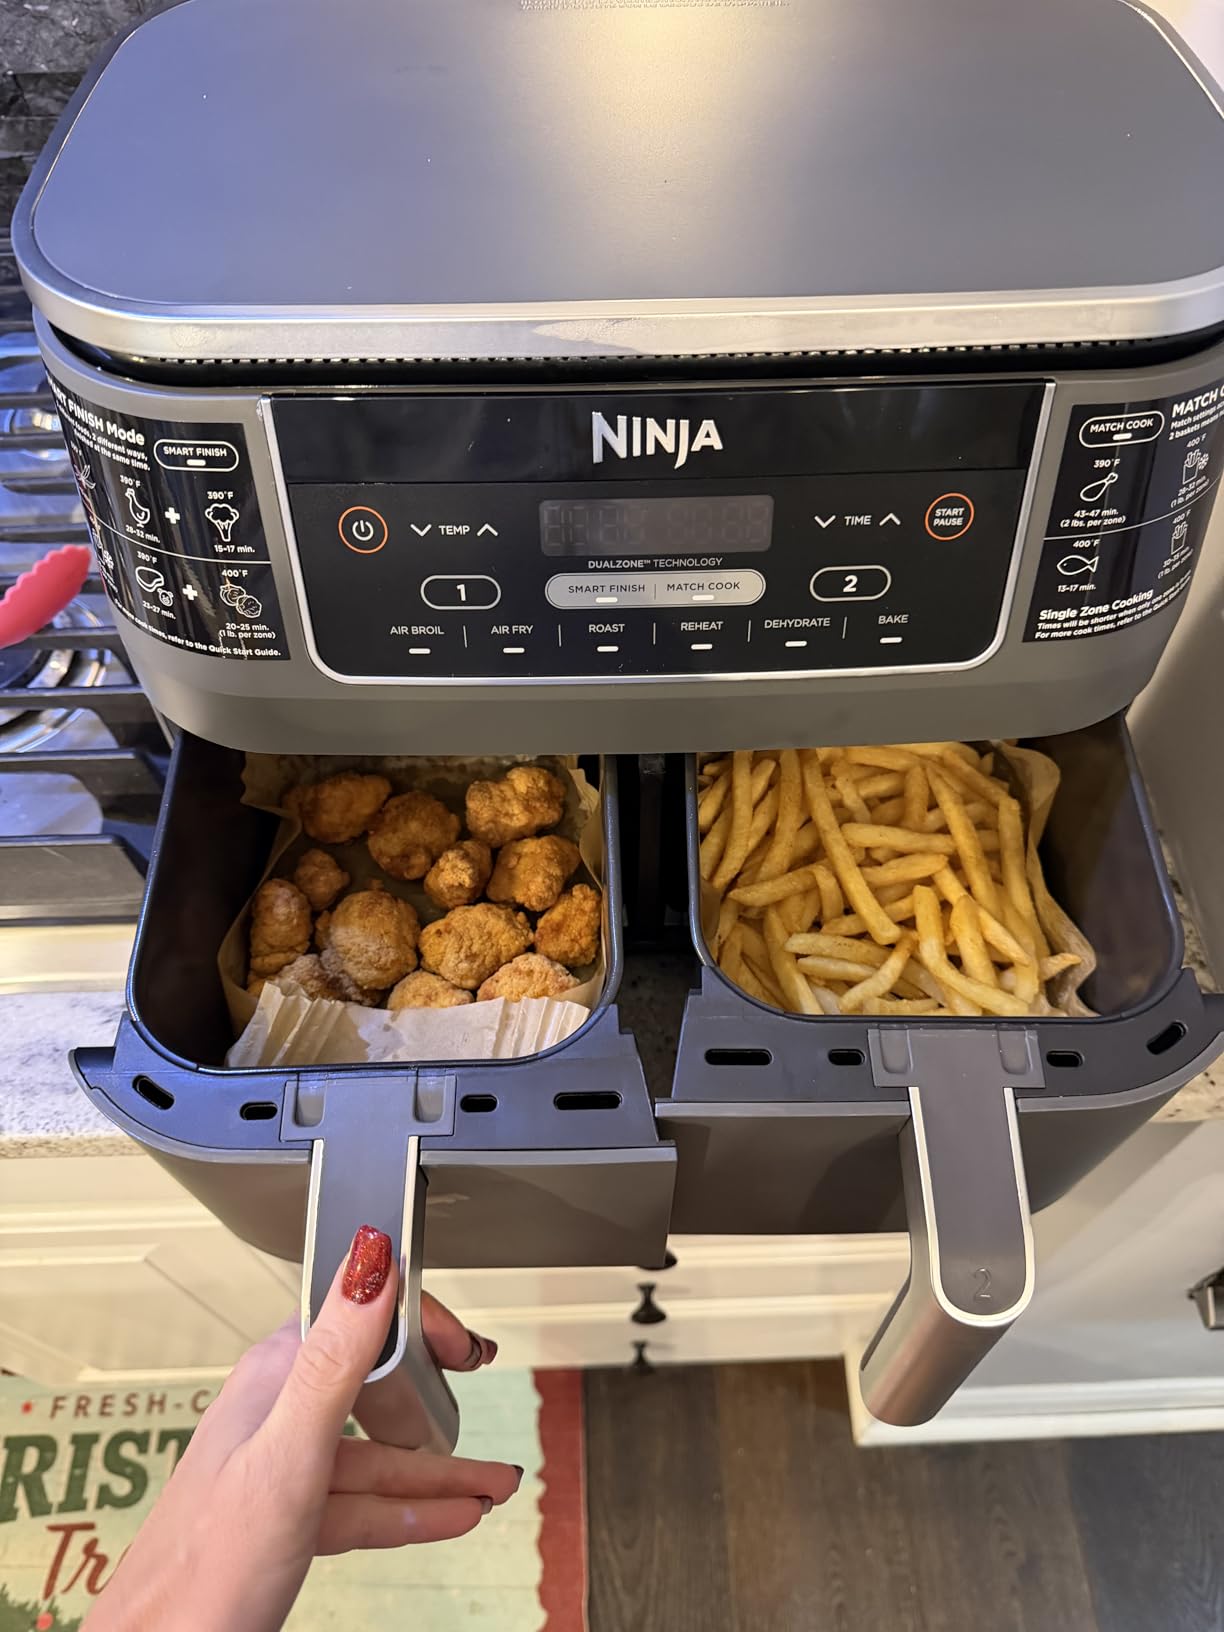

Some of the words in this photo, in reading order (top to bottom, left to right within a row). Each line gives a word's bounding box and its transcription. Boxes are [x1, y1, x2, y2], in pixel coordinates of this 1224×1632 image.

[1172, 387, 1219, 419] MATCH
[68, 399, 104, 432] FINISH
[106, 421, 145, 446] Mode
[1089, 421, 1124, 433] MATCH
[1126, 418, 1154, 430] COOK
[1171, 416, 1192, 430] Match
[1169, 432, 1174, 440] 2
[1175, 423, 1200, 438] baskets
[592, 411, 723, 470] NINJA
[92, 432, 97, 443] 2
[97, 436, 126, 454] different
[126, 448, 148, 462] ways,
[163, 446, 194, 456] SMART
[196, 447, 227, 457] FINISH
[94, 443, 100, 453] at
[100, 446, 111, 458] the
[112, 453, 130, 465] same
[131, 458, 150, 471] time.
[935, 507, 965, 518] START
[1074, 509, 1101, 518] 43-47
[1101, 507, 1119, 516] min.
[844, 515, 872, 526] TIME
[933, 517, 963, 527] PAUSE
[1071, 518, 1086, 527] lbs.
[1087, 518, 1102, 528] per
[1103, 515, 1126, 526] zone)
[438, 525, 470, 536] TEMP
[145, 533, 161, 543] min.
[214, 544, 235, 553] 15-17
[237, 545, 256, 553] min.
[653, 557, 723, 568] TECHNOLOGY
[568, 585, 607, 593] SMART
[609, 584, 646, 593] FINISH
[666, 582, 705, 591] MATCH
[708, 581, 741, 591] COOK
[843, 575, 858, 593] 2
[1057, 584, 1079, 593] 13-17
[1079, 583, 1096, 591] min.
[456, 584, 467, 601] 1
[1039, 608, 1078, 621] Single
[1080, 604, 1110, 617] Zone
[1112, 589, 1154, 610] Cooking
[161, 609, 176, 620] min.
[878, 614, 909, 625] BAKE
[1037, 622, 1061, 630] Times
[1062, 620, 1077, 628] will
[1090, 613, 1117, 624] shorter
[1118, 607, 1136, 618] when
[1137, 601, 1151, 611] only
[225, 622, 250, 631] 20-25
[252, 623, 270, 631] min.
[588, 623, 625, 634] ROAST
[680, 621, 724, 632] REHEAT
[764, 617, 831, 629] DEHYDRATE
[1034, 631, 1050, 639] For
[1050, 630, 1072, 638] more
[1073, 626, 1093, 636] cook
[1116, 616, 1134, 627] refer
[1134, 613, 1142, 621] to
[1142, 608, 1153, 617] the
[227, 630, 237, 638] lb.
[238, 631, 251, 640] per
[253, 631, 276, 639] zone)
[390, 625, 409, 635] AIR
[411, 625, 445, 635] BROIL
[491, 625, 509, 635] AIR
[512, 625, 534, 635] FRY
[148, 625, 167, 640] times,
[167, 634, 184, 645] refer
[185, 640, 194, 648] to
[194, 642, 208, 651] the
[208, 645, 232, 655] Quick
[232, 647, 253, 656] Start
[254, 648, 281, 656] Guide.
[973, 1267, 992, 1301] 2
[50, 1389, 211, 1419] FRESH-C
